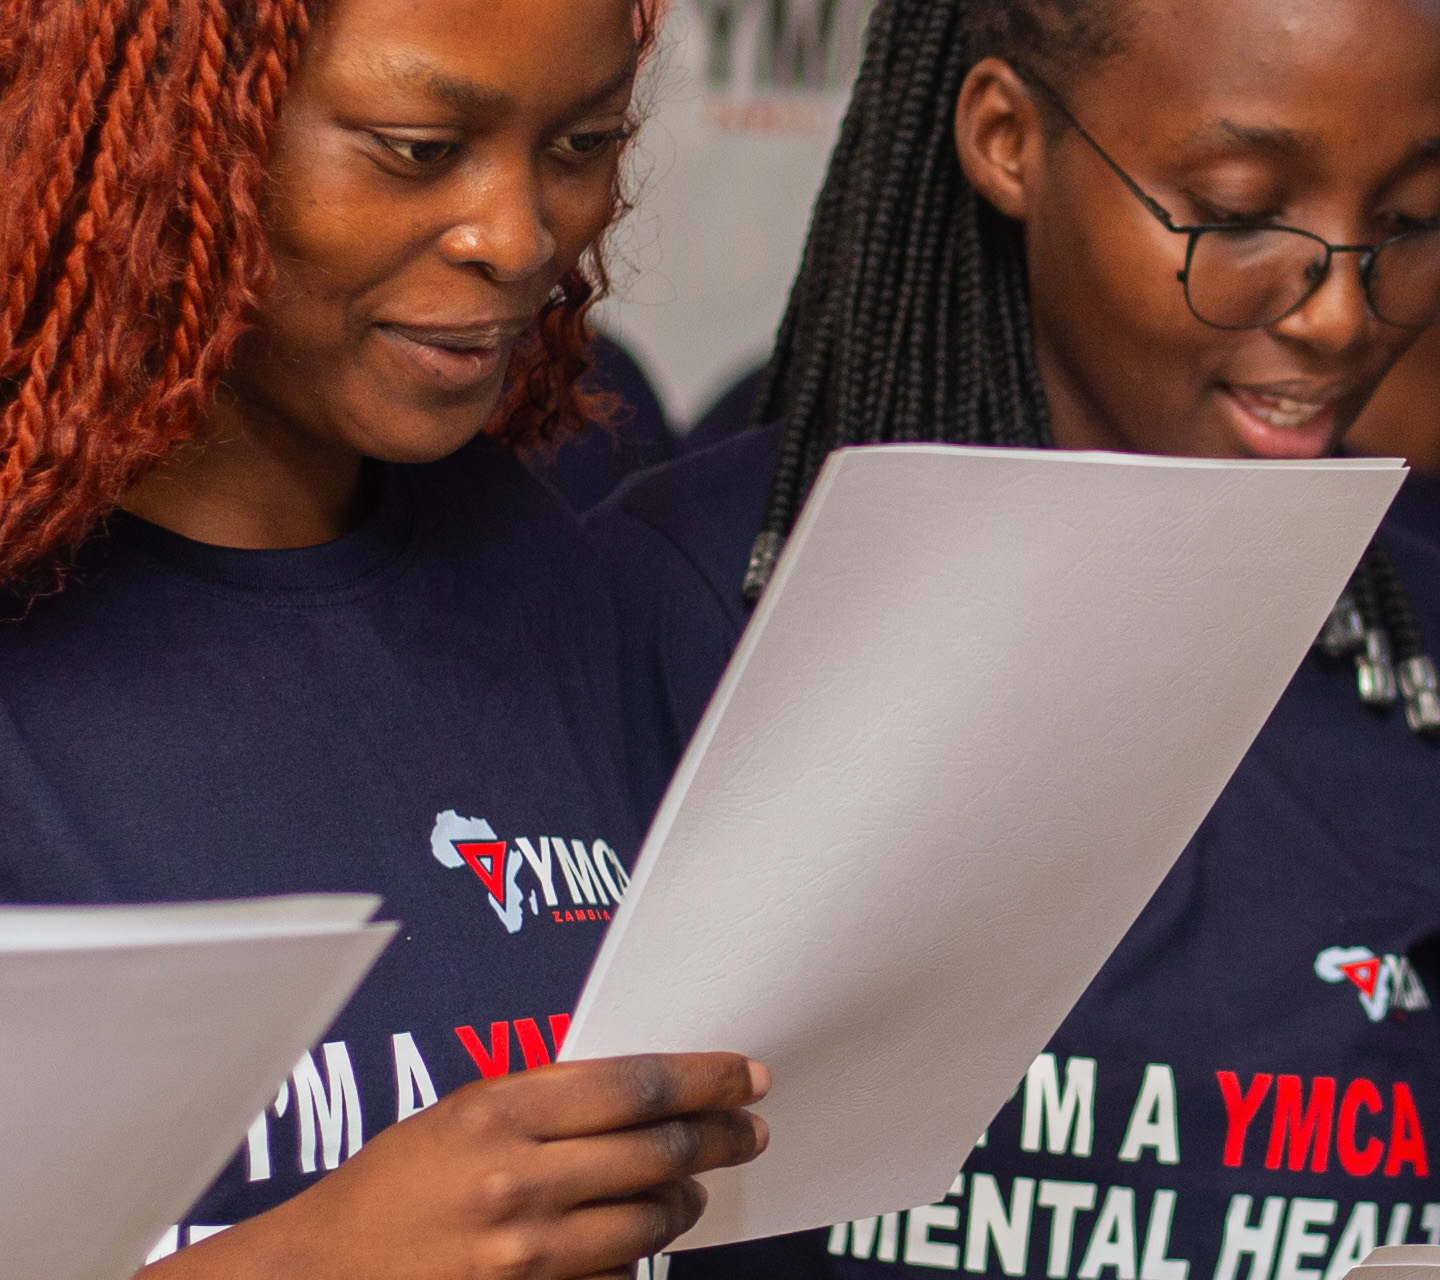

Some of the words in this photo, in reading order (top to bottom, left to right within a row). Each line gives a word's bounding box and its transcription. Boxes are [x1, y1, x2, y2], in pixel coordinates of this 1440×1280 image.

[392, 1031, 439, 1124] A
[1118, 1063, 1179, 1164] A
[1215, 1070, 1429, 1178] YMCA
